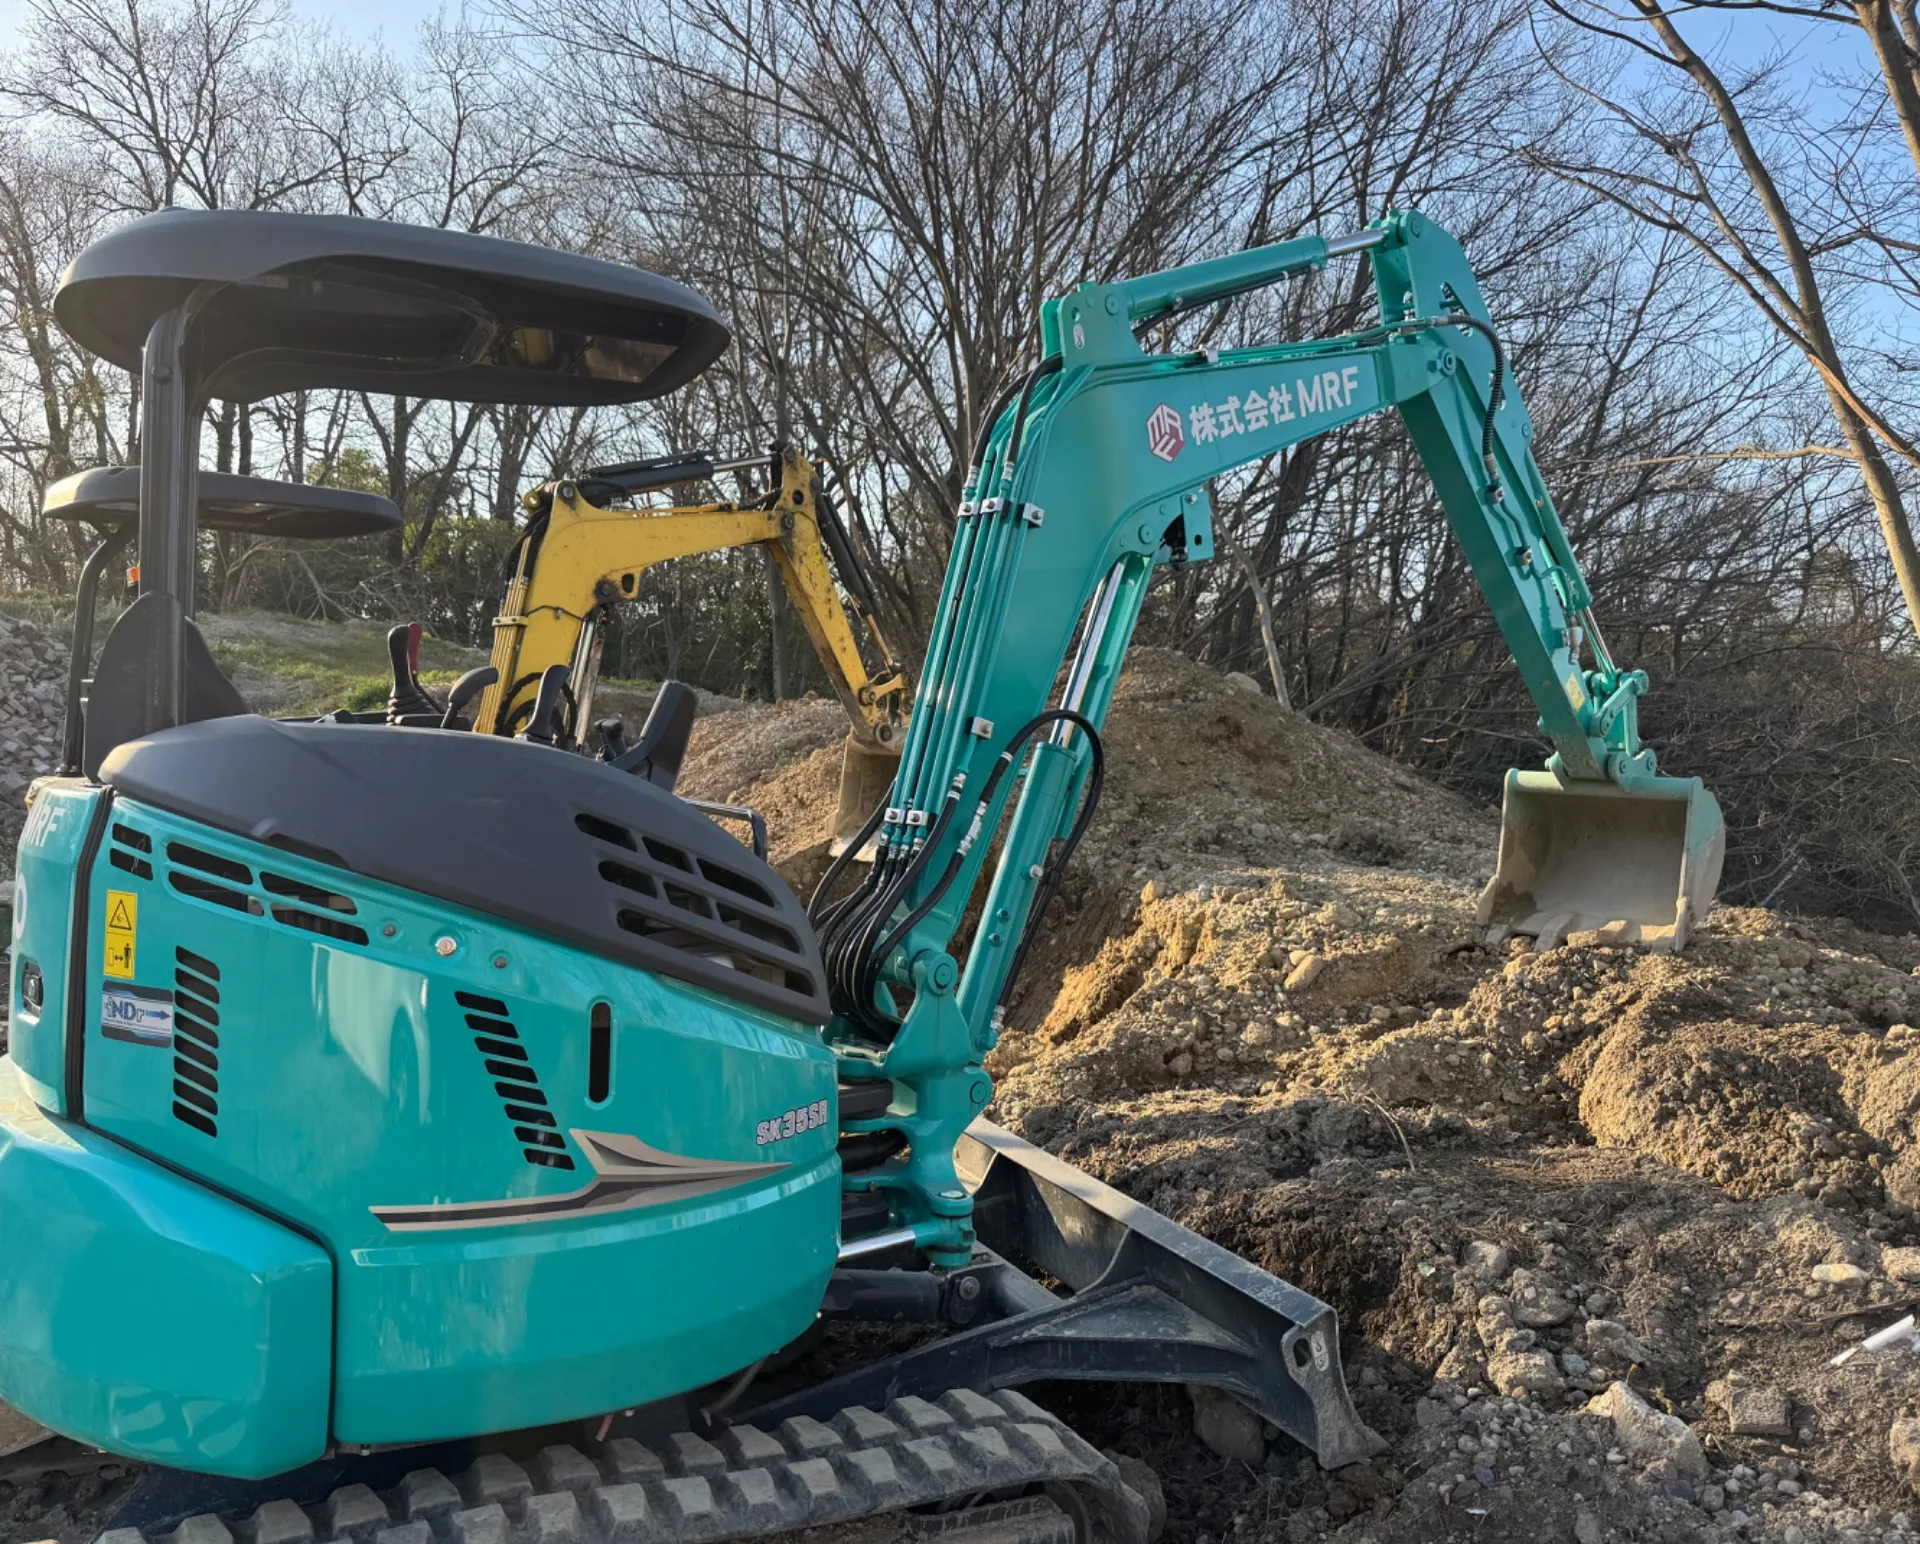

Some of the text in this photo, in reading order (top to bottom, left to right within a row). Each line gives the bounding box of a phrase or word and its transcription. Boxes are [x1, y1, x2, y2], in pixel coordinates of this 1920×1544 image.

[1189, 366, 1359, 446] 株式会社 MRF
